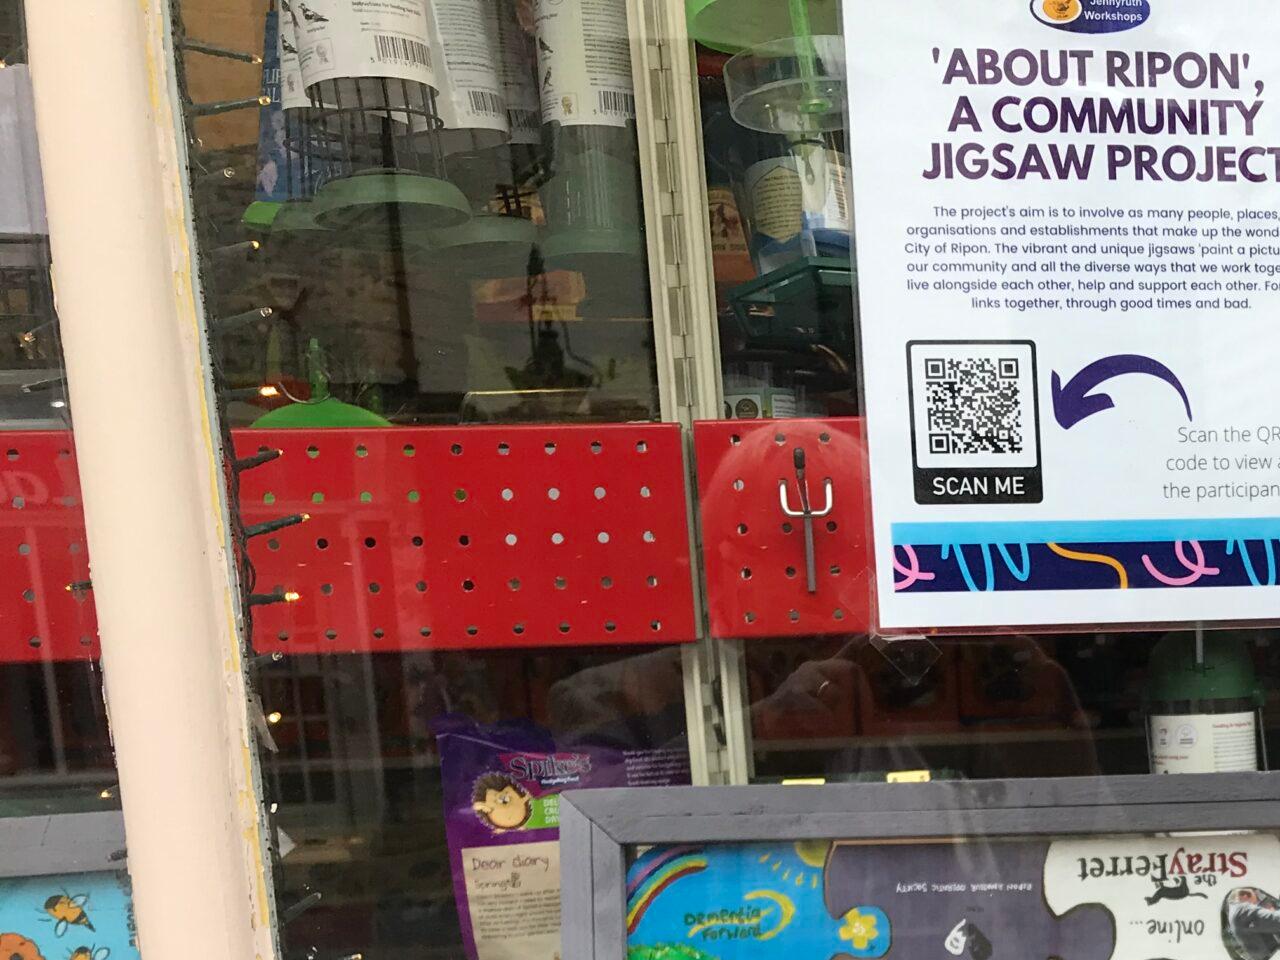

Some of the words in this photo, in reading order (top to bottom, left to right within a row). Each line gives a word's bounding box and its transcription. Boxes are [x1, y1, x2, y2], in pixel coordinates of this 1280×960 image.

[1084, 10, 1143, 23] Workshops
[932, 47, 1094, 87] 'ABOUT
[947, 95, 983, 133] A
[991, 95, 1264, 136] COMMUNITY
[922, 142, 1095, 181] JIGSAW
[933, 206, 957, 217] The
[961, 205, 1016, 221] project's
[1019, 208, 1045, 218] aim
[1048, 206, 1059, 218] is
[1062, 207, 1076, 218] to
[1079, 206, 1124, 218] involve
[1127, 209, 1143, 218] as
[1147, 209, 1184, 222] many
[1187, 207, 1233, 222] people,
[1237, 208, 1280, 223] places,
[906, 225, 997, 239] organisations
[1000, 224, 1026, 236] and
[1029, 224, 1129, 237] establishments
[1132, 225, 1159, 237] that
[1162, 225, 1198, 237] make
[1201, 228, 1219, 241] up
[1221, 226, 1242, 238] the
[904, 242, 931, 257] City
[934, 242, 947, 254] of
[951, 242, 991, 257] Ripon.
[994, 242, 1019, 254] The
[1021, 242, 1068, 254] vibrant
[1071, 243, 1097, 254] and
[1100, 243, 1145, 258] unique
[1147, 243, 1195, 258] jigsaws
[1198, 243, 1234, 258] 'paint
[1237, 246, 1245, 255] a
[906, 263, 929, 272] our
[932, 261, 1008, 275] community
[1011, 261, 1037, 273] and
[1040, 261, 1056, 273] all
[1059, 261, 1081, 273] the
[1084, 260, 1131, 273] diverse
[1133, 263, 1167, 277] ways
[1170, 261, 1197, 273] that
[1199, 263, 1218, 273] we
[1221, 261, 1251, 273] work
[907, 279, 929, 291] live
[933, 279, 997, 294] alongside
[1001, 279, 1034, 291] each
[1037, 279, 1075, 292] other,
[1077, 279, 1106, 294] help
[1109, 279, 1135, 292] and
[1137, 280, 1187, 294] support
[1190, 279, 1222, 291] each
[1225, 279, 1261, 291] other.
[971, 297, 1001, 309] links
[1004, 297, 1063, 312] together,
[1065, 297, 1117, 313] through
[1119, 297, 1153, 313] good
[1156, 297, 1192, 309] times
[1195, 297, 1220, 309] and
[1223, 297, 1251, 309] bad.
[1177, 426, 1218, 443] Scan
[1223, 426, 1251, 443] the
[1166, 454, 1208, 471] code
[1212, 456, 1230, 471] to
[1234, 454, 1273, 471] view
[932, 476, 988, 496] SCAN
[995, 476, 1025, 495] ME
[1162, 481, 1191, 499] the
[512, 854, 550, 874] diary
